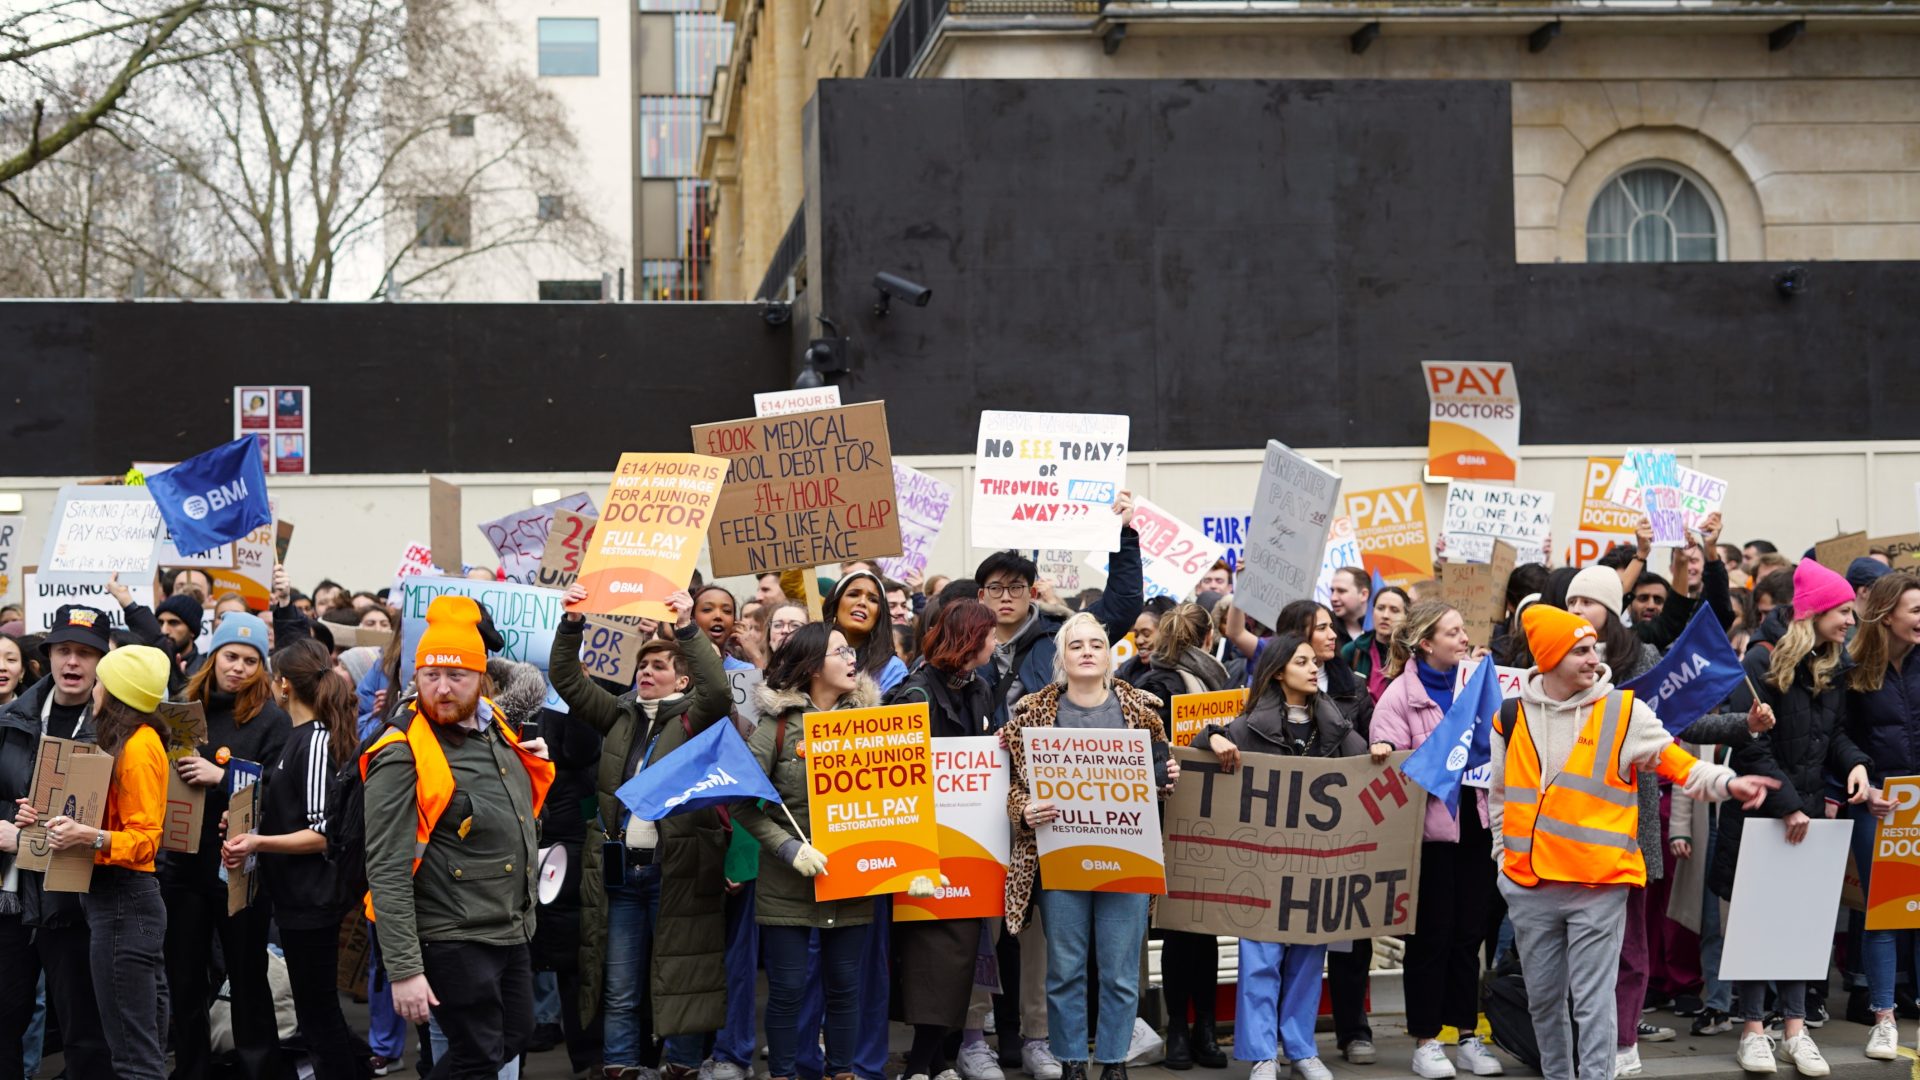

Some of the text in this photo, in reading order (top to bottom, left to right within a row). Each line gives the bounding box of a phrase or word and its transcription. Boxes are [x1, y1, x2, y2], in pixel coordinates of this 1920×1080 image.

[1428, 367, 1506, 395] PAY
[761, 397, 821, 412] £14/HOUR
[823, 394, 836, 404] IS
[1435, 403, 1514, 419] DOCTORS
[707, 414, 859, 454] £100K MEDICAL
[779, 447, 826, 478] DEBT
[834, 441, 884, 472] FOR
[985, 438, 1014, 458] NO
[1060, 441, 1081, 460] TO
[1084, 442, 1125, 461] PAY?
[621, 461, 720, 480] £14/HOUR IS
[1039, 464, 1058, 477] OR
[1267, 451, 1327, 500] UNFAIR
[205, 476, 249, 512] BMA
[616, 476, 716, 493] NOT A FAIR WAGE
[908, 473, 940, 498] NHS
[980, 479, 1114, 503] THROWING NHS
[611, 489, 711, 508] FOR A JUNIOR
[1269, 481, 1312, 523] PAY
[1348, 488, 1419, 529] PAY
[1450, 487, 1544, 509] AN INJURY
[67, 501, 119, 519] STRIKING
[604, 503, 705, 529] DOCTOR
[1012, 503, 1089, 521] AWAY???
[1449, 503, 1468, 518] TO
[1473, 506, 1506, 520] ONE
[1513, 511, 1528, 523] IS
[67, 524, 94, 542] PAY
[720, 514, 777, 546] FEELS
[785, 510, 820, 538] LIKE
[826, 508, 840, 532] A
[846, 499, 891, 530] CLAP
[1446, 518, 1496, 534] INJURY
[1500, 523, 1514, 537] TO
[603, 530, 646, 548] FULL
[650, 532, 688, 550] PAY
[1131, 513, 1174, 554] SALE
[1357, 529, 1425, 552] DOCTORS
[600, 547, 682, 561] RESTORATION NOW
[747, 530, 859, 571] IN THE FACE
[1251, 542, 1307, 593] DOCTOR
[620, 581, 644, 594] BMA
[436, 654, 462, 664] BMA
[1658, 652, 1712, 701] BMA
[1177, 698, 1246, 719] £14/HOUR IS
[811, 714, 923, 739] £14/HOUR IS
[1176, 719, 1195, 732] NOT
[1195, 719, 1202, 730] A
[811, 731, 925, 754] NOT A FAIR WAGE
[1031, 737, 1145, 753] £14/HOUR IS
[1578, 736, 1594, 746] BMA
[813, 746, 925, 771] FOR A JUNIOR
[931, 750, 1002, 770] FICIAL
[1032, 754, 1146, 766] NOT A FAIR WAGE
[814, 763, 927, 796] DOCTOR
[1034, 766, 1148, 781] FOR A JUNIOR
[1036, 780, 1150, 803] DOCTOR
[1180, 759, 1348, 832] THIS
[827, 796, 919, 823] FULL PAY
[1051, 809, 1142, 827] FULL PAY
[828, 814, 920, 833] RESTORATION NOW
[1052, 825, 1143, 836] RESTORATION NOW
[1174, 819, 1369, 874] IS GOING
[869, 856, 897, 871] BMA
[1094, 860, 1121, 871] BMA
[946, 886, 971, 898] BMA
[1171, 863, 1268, 929] TO
